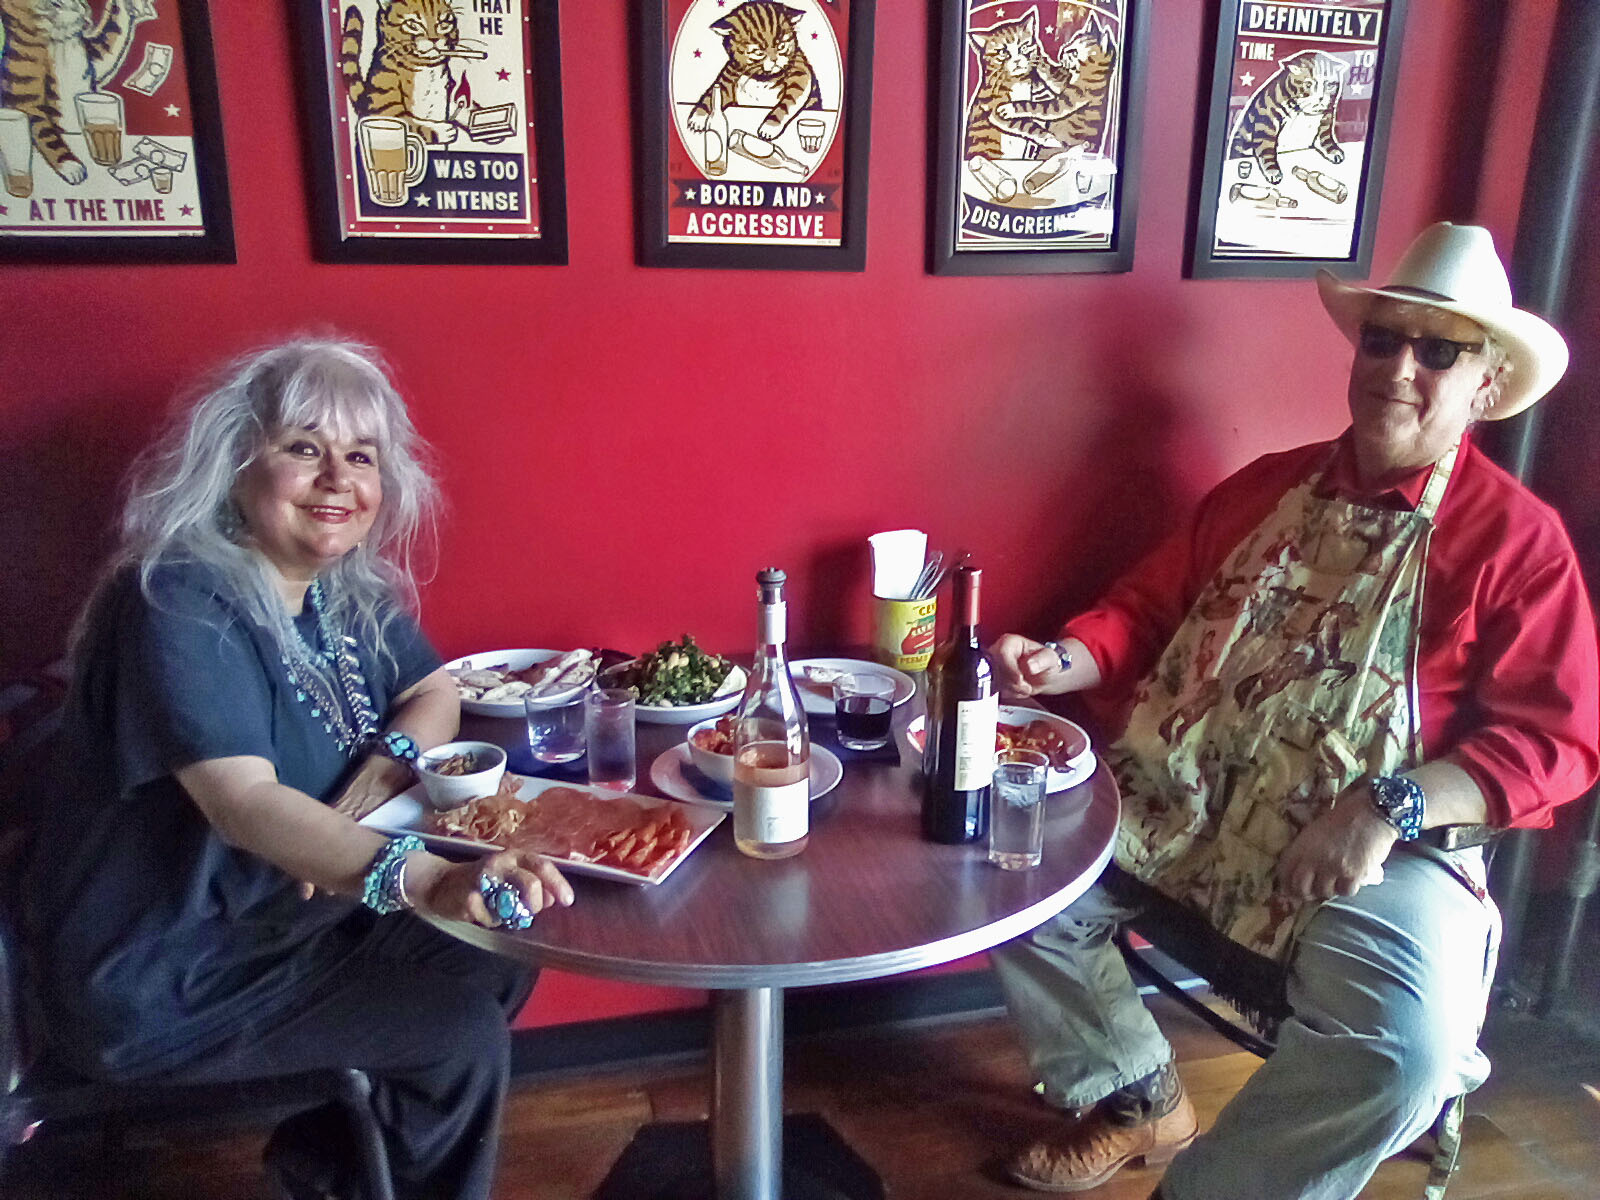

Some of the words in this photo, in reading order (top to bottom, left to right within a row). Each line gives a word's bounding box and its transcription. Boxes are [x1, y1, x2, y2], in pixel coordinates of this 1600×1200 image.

[480, 17, 503, 36] HE
[1249, 4, 1372, 37] DEFINITELY
[1240, 41, 1275, 61] TIME
[1354, 50, 1375, 68] TO
[433, 159, 477, 179] WAS
[480, 160, 519, 180] TOO
[436, 190, 519, 211] INTENSE
[700, 184, 765, 206] BORED
[772, 186, 812, 208] AND
[29, 198, 56, 221] AT
[64, 198, 108, 221] THE
[113, 199, 165, 222] TIME
[686, 212, 824, 237] AGGRESSIVE
